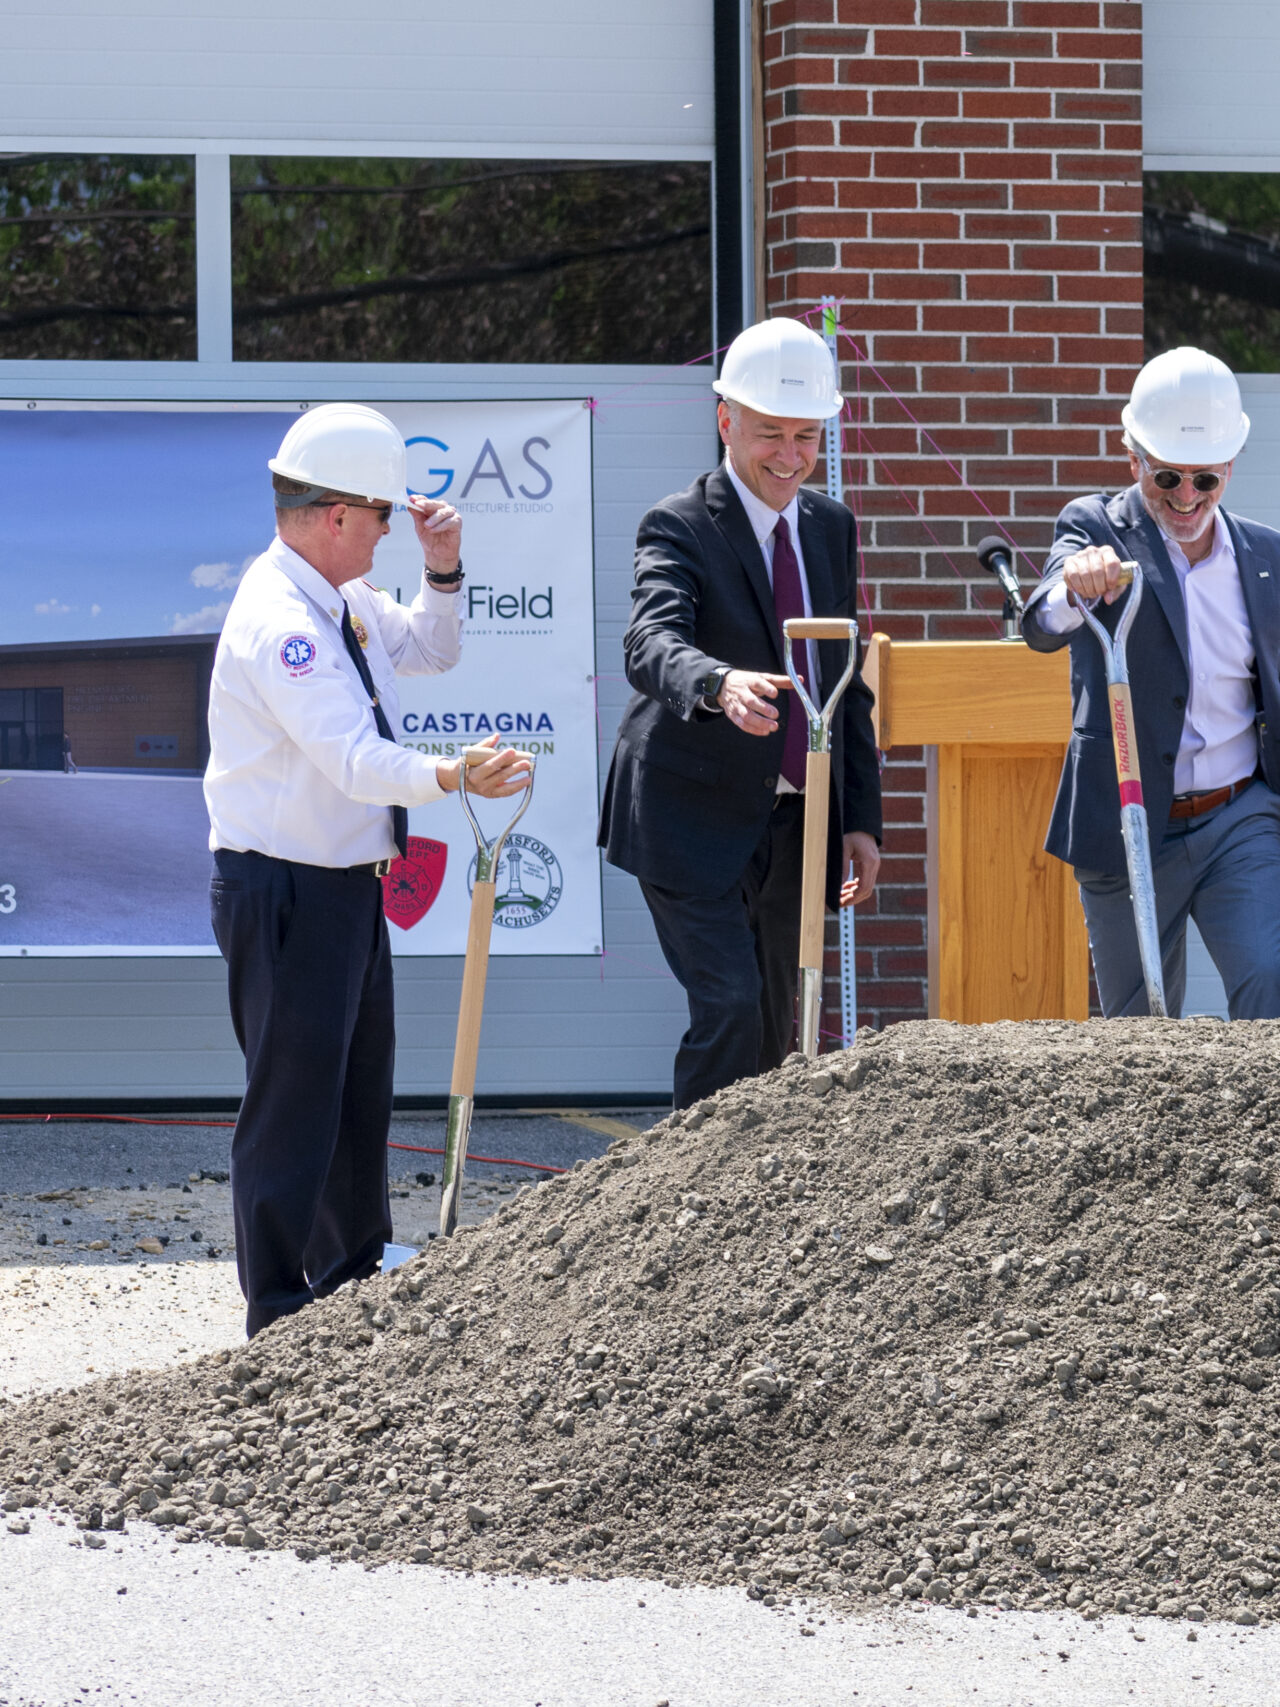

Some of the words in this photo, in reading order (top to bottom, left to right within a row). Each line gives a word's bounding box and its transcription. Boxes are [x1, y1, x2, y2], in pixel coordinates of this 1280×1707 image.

[405, 436, 553, 500] GAS
[449, 502, 510, 513] HITECTURE
[514, 502, 553, 513] STUDIO
[464, 586, 553, 619] Field
[402, 713, 554, 733] CASTAGNA
[1113, 699, 1131, 774] RAZORBACK
[504, 836, 555, 865] MSFORD
[0, 884, 16, 913] 3
[493, 886, 561, 926] ACHUSETTS
